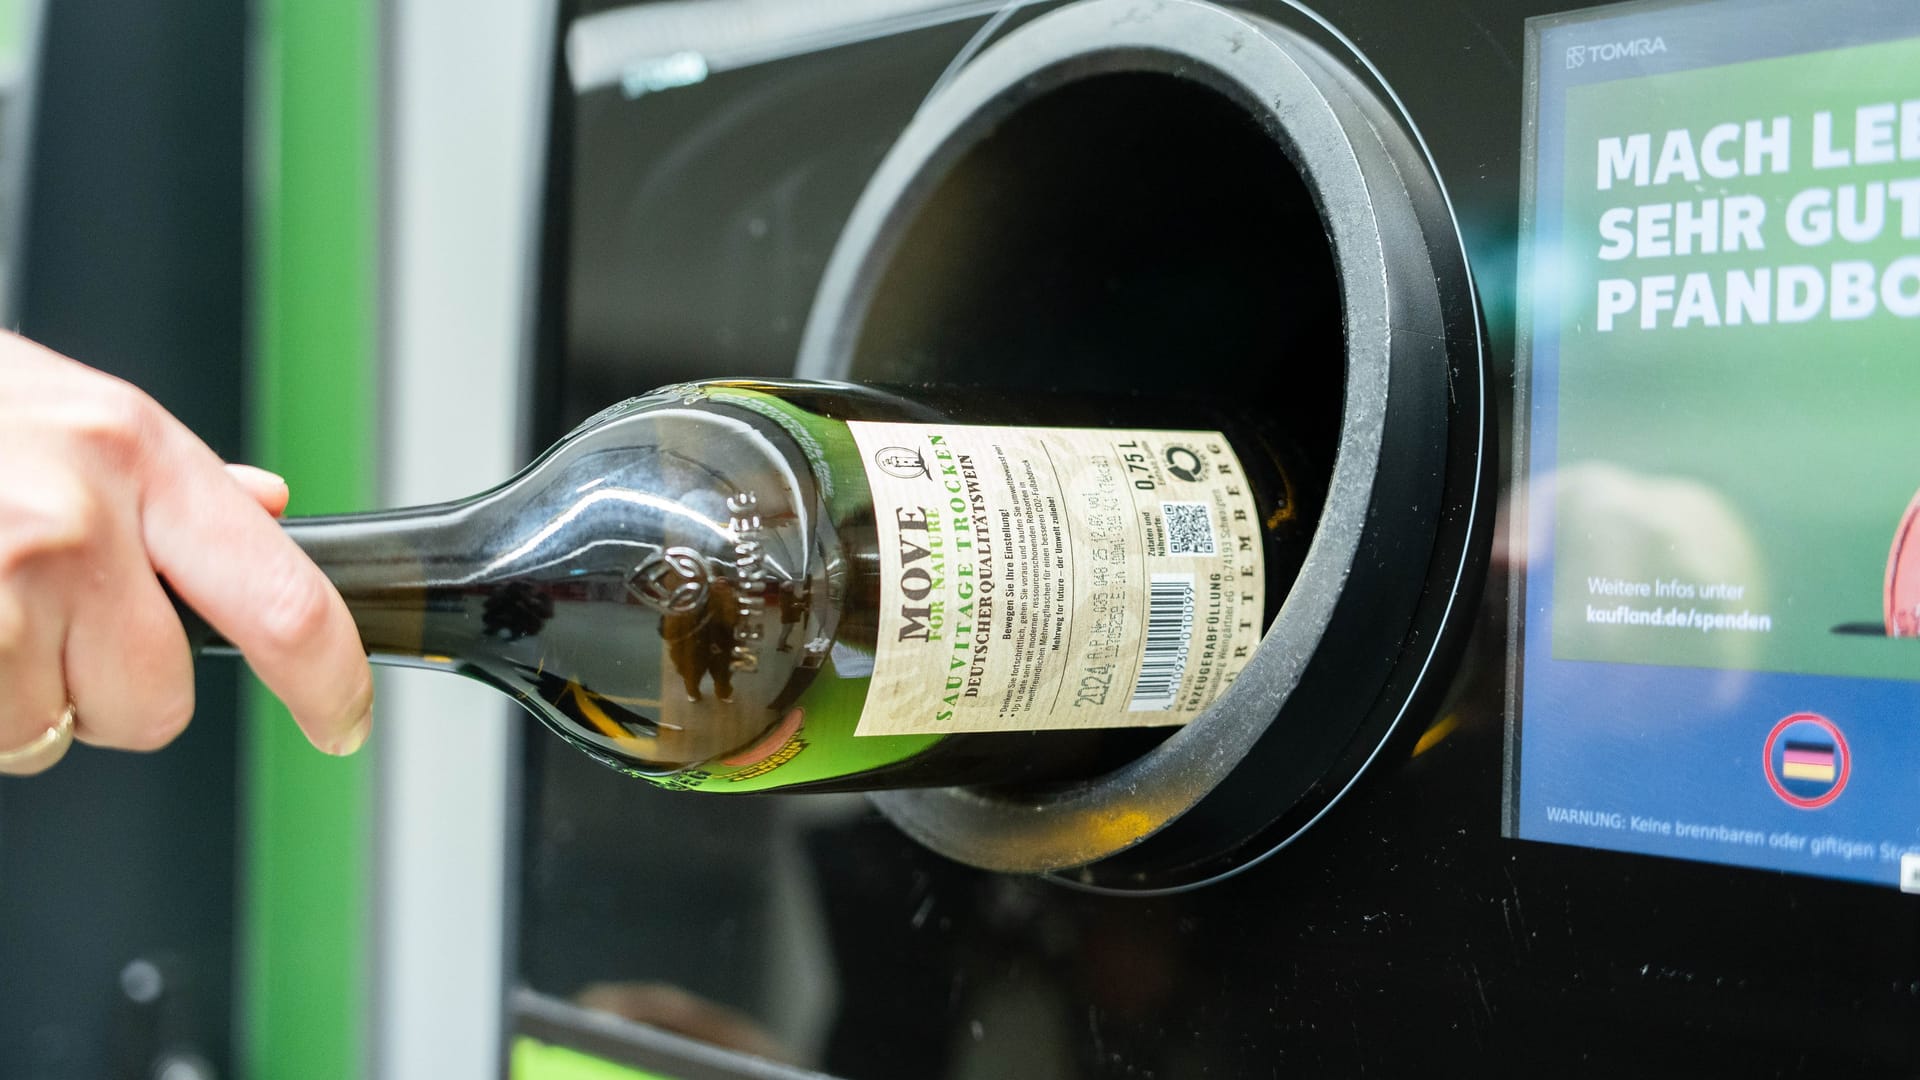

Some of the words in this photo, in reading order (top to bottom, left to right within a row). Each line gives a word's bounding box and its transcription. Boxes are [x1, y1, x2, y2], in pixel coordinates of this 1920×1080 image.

[1588, 36, 1667, 63] TOMRA
[1597, 116, 1791, 190] MACH
[1598, 195, 1766, 261] SEHR
[1785, 177, 1920, 247] GUT
[1597, 255, 1920, 332] PFANDBO
[1118, 440, 1138, 448] L
[998, 456, 1020, 504] umweltbewusst
[1123, 454, 1155, 490] 0,75
[928, 434, 972, 552] TROCKEN
[1021, 490, 1034, 524] Rebsorten
[1013, 506, 1022, 517] Sie
[1046, 496, 1060, 524] zuliebe!
[1142, 512, 1152, 526] und
[998, 509, 1013, 560] Einstellung!
[1016, 519, 1025, 543] kaufen
[1038, 514, 1048, 546] besseren
[1053, 526, 1063, 554] Umwelt
[1144, 528, 1156, 557] Zutaten
[1153, 515, 1165, 556] Nährwerte:
[926, 508, 945, 589] NATURE
[1056, 556, 1064, 568] der
[896, 506, 932, 642] MOVE
[1005, 562, 1014, 580] Ihre
[1028, 526, 1039, 608] ressourcenschonenden
[1042, 570, 1050, 580] für
[1006, 584, 1014, 597] Sie
[1020, 588, 1028, 600] Sie
[1055, 578, 1064, 602] future
[1588, 576, 1651, 597] Weitere
[1655, 577, 1695, 598] Infos
[1699, 580, 1745, 600] unter
[928, 601, 944, 640] FOR
[1002, 600, 1014, 640] Bewegen
[1019, 602, 1028, 624] gehen
[1040, 583, 1051, 646] Mehrwegflaschen
[1056, 604, 1064, 615] for
[1181, 586, 1194, 640] 010099
[1586, 604, 1772, 633] kaufland.de/spenden
[936, 563, 973, 721] SAUVITAGE
[1052, 617, 1064, 650] Mehrweg
[1186, 573, 1220, 712] ERZEUGERABFÜLLUNG
[1010, 626, 1027, 676] fortschrittlich,
[1025, 650, 1034, 662] mit
[1008, 678, 1016, 688] Sie
[1022, 664, 1031, 678] sein
[1018, 679, 1028, 694] date
[1073, 664, 1116, 708] 2024
[999, 690, 1013, 712] Denken
[1011, 703, 1021, 712] Up
[1546, 805, 1626, 830] WARNUNG:
[1631, 816, 1671, 837] Keine
[1675, 821, 1765, 848] brennbaren
[1769, 831, 1806, 850] oder
[1811, 836, 1874, 861] giftigen
